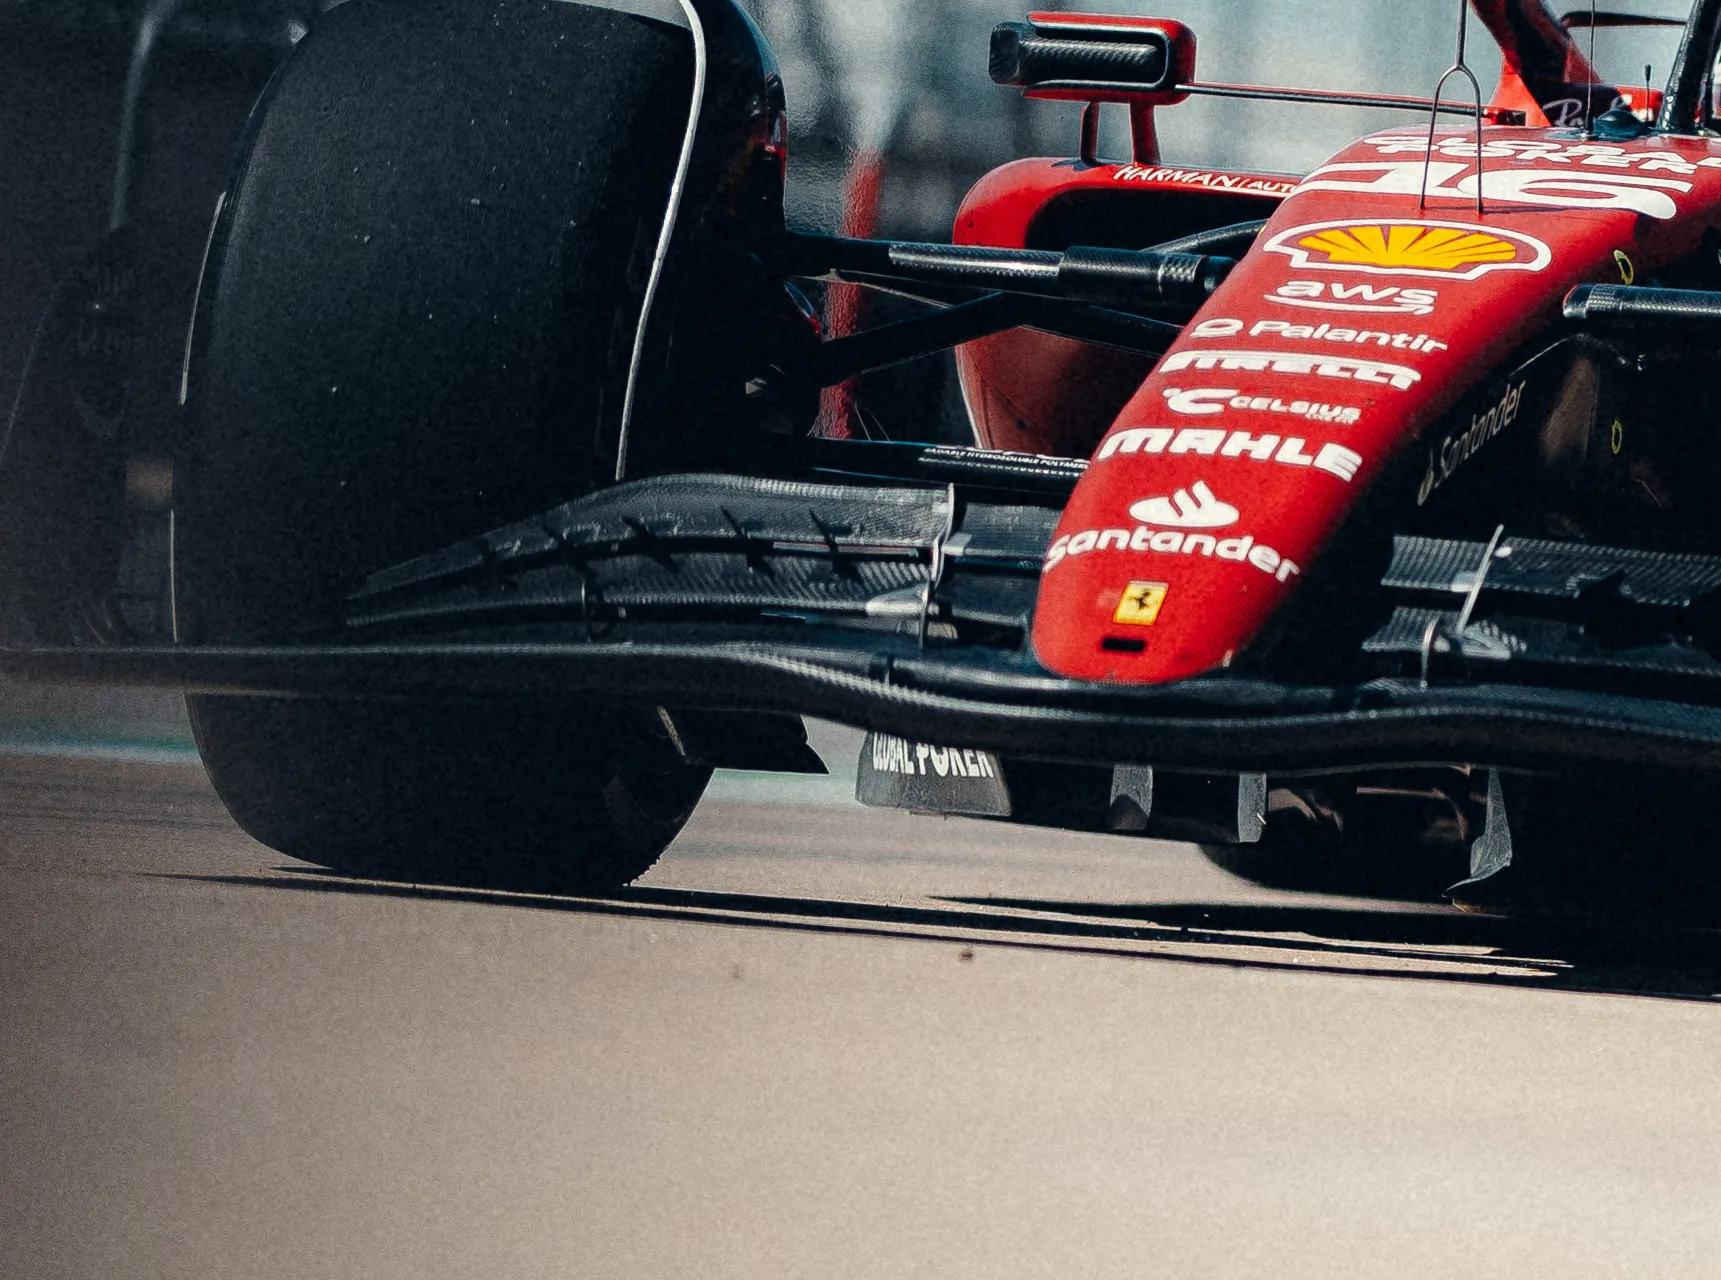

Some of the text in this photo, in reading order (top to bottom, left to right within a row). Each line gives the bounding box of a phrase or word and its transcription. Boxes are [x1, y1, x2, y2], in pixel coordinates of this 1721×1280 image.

[1113, 165, 1240, 188] HARMAN
[1376, 143, 1699, 175] POKER
[1284, 160, 1695, 220] 16
[1276, 280, 1439, 307] aws
[1249, 319, 1448, 354] Palantir
[1158, 349, 1422, 392] PIRELLI
[1229, 395, 1362, 422] CELSIUS
[1434, 379, 1527, 489] Santander
[1096, 427, 1364, 483] MAHLE
[1041, 525, 1300, 583] Santander
